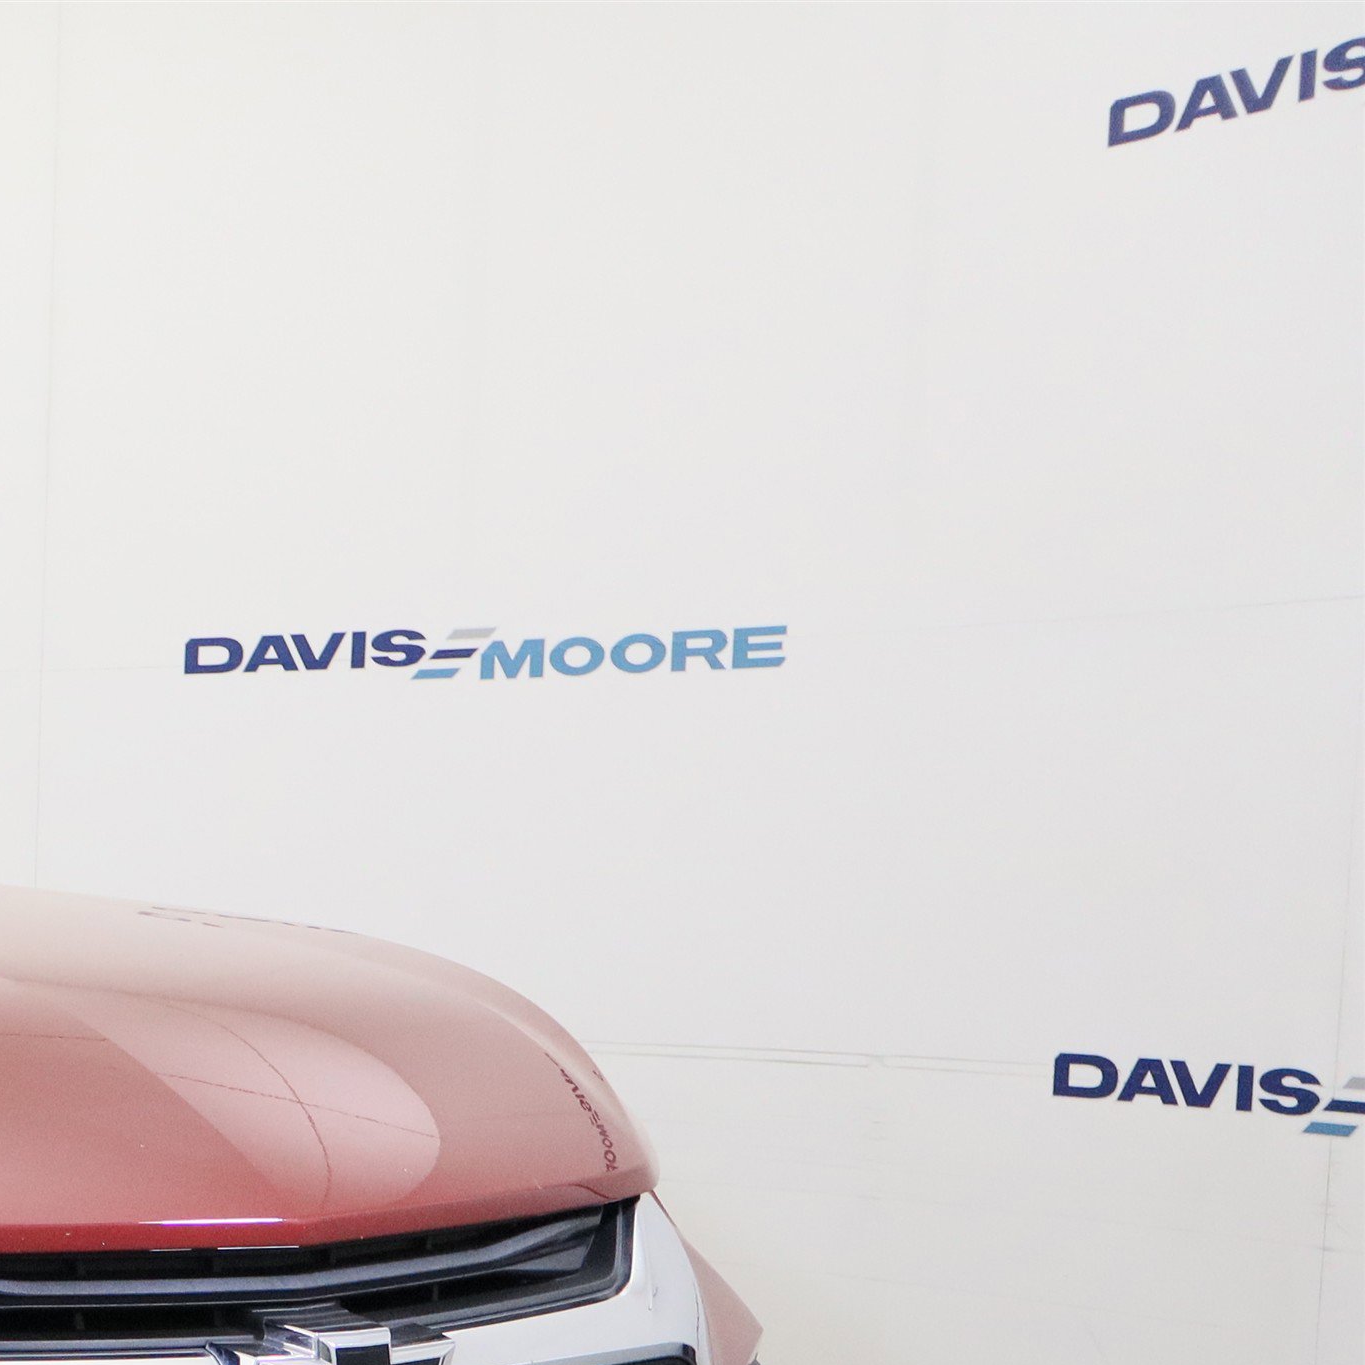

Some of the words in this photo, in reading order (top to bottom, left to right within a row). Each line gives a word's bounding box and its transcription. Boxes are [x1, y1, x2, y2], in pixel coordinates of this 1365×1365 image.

[183, 628, 427, 676] DAVIS
[479, 624, 788, 681] MOORE
[1052, 1052, 1323, 1117] DAVIS
